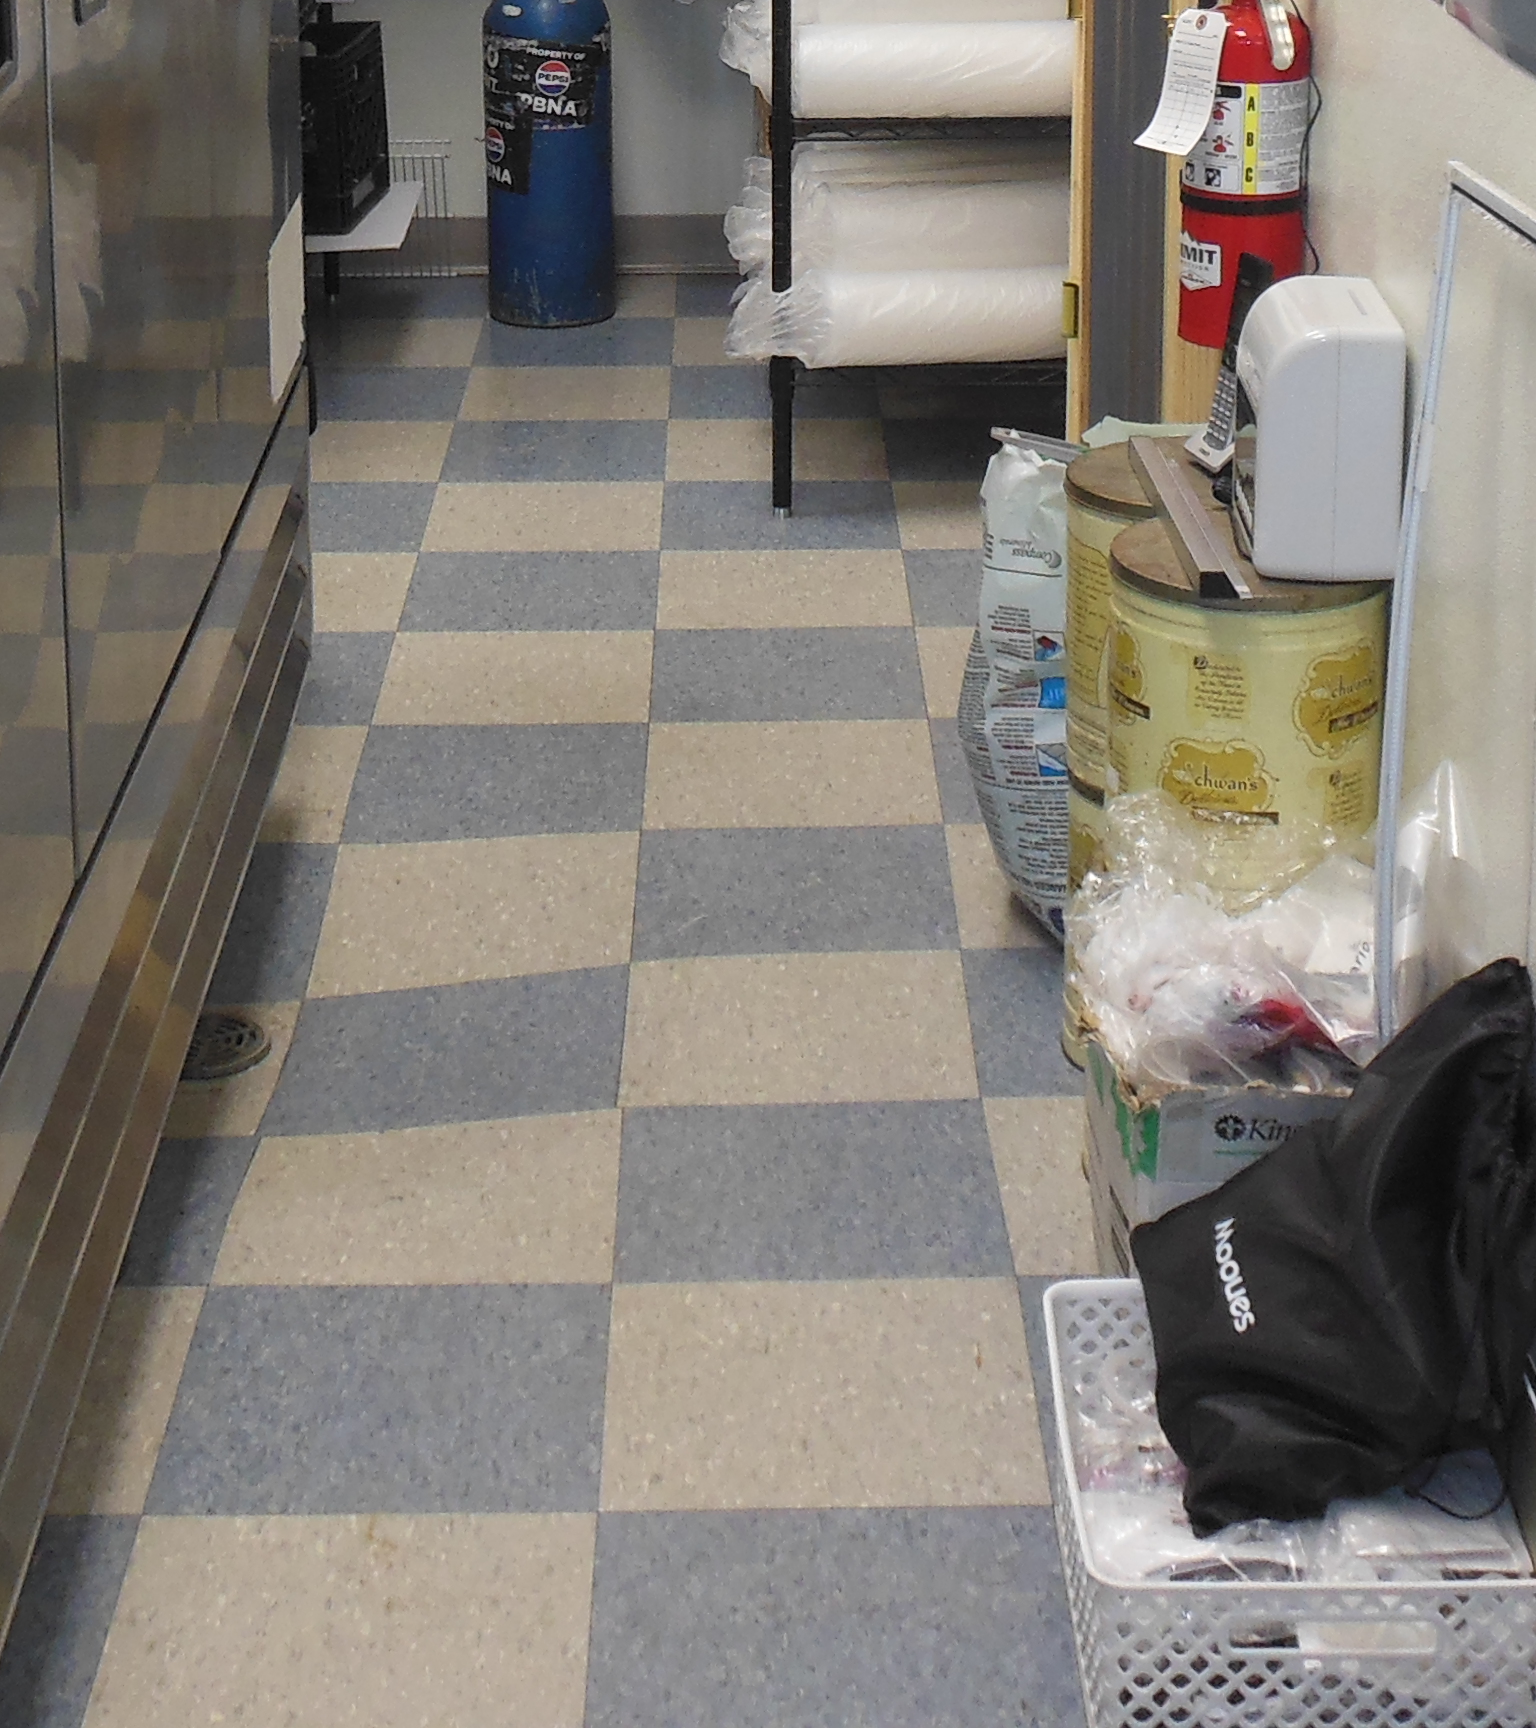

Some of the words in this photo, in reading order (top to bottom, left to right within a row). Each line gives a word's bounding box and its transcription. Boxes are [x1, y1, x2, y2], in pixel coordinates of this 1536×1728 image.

[526, 46, 573, 59] PROPERTY
[574, 52, 587, 61] OF
[538, 72, 569, 83] PEPSI
[515, 92, 577, 117] PBNA
[1247, 96, 1255, 112] A
[1246, 132, 1254, 147] B
[1245, 167, 1253, 183] C
[1181, 243, 1218, 265] MIT
[1249, 1118, 1297, 1142] Kin
